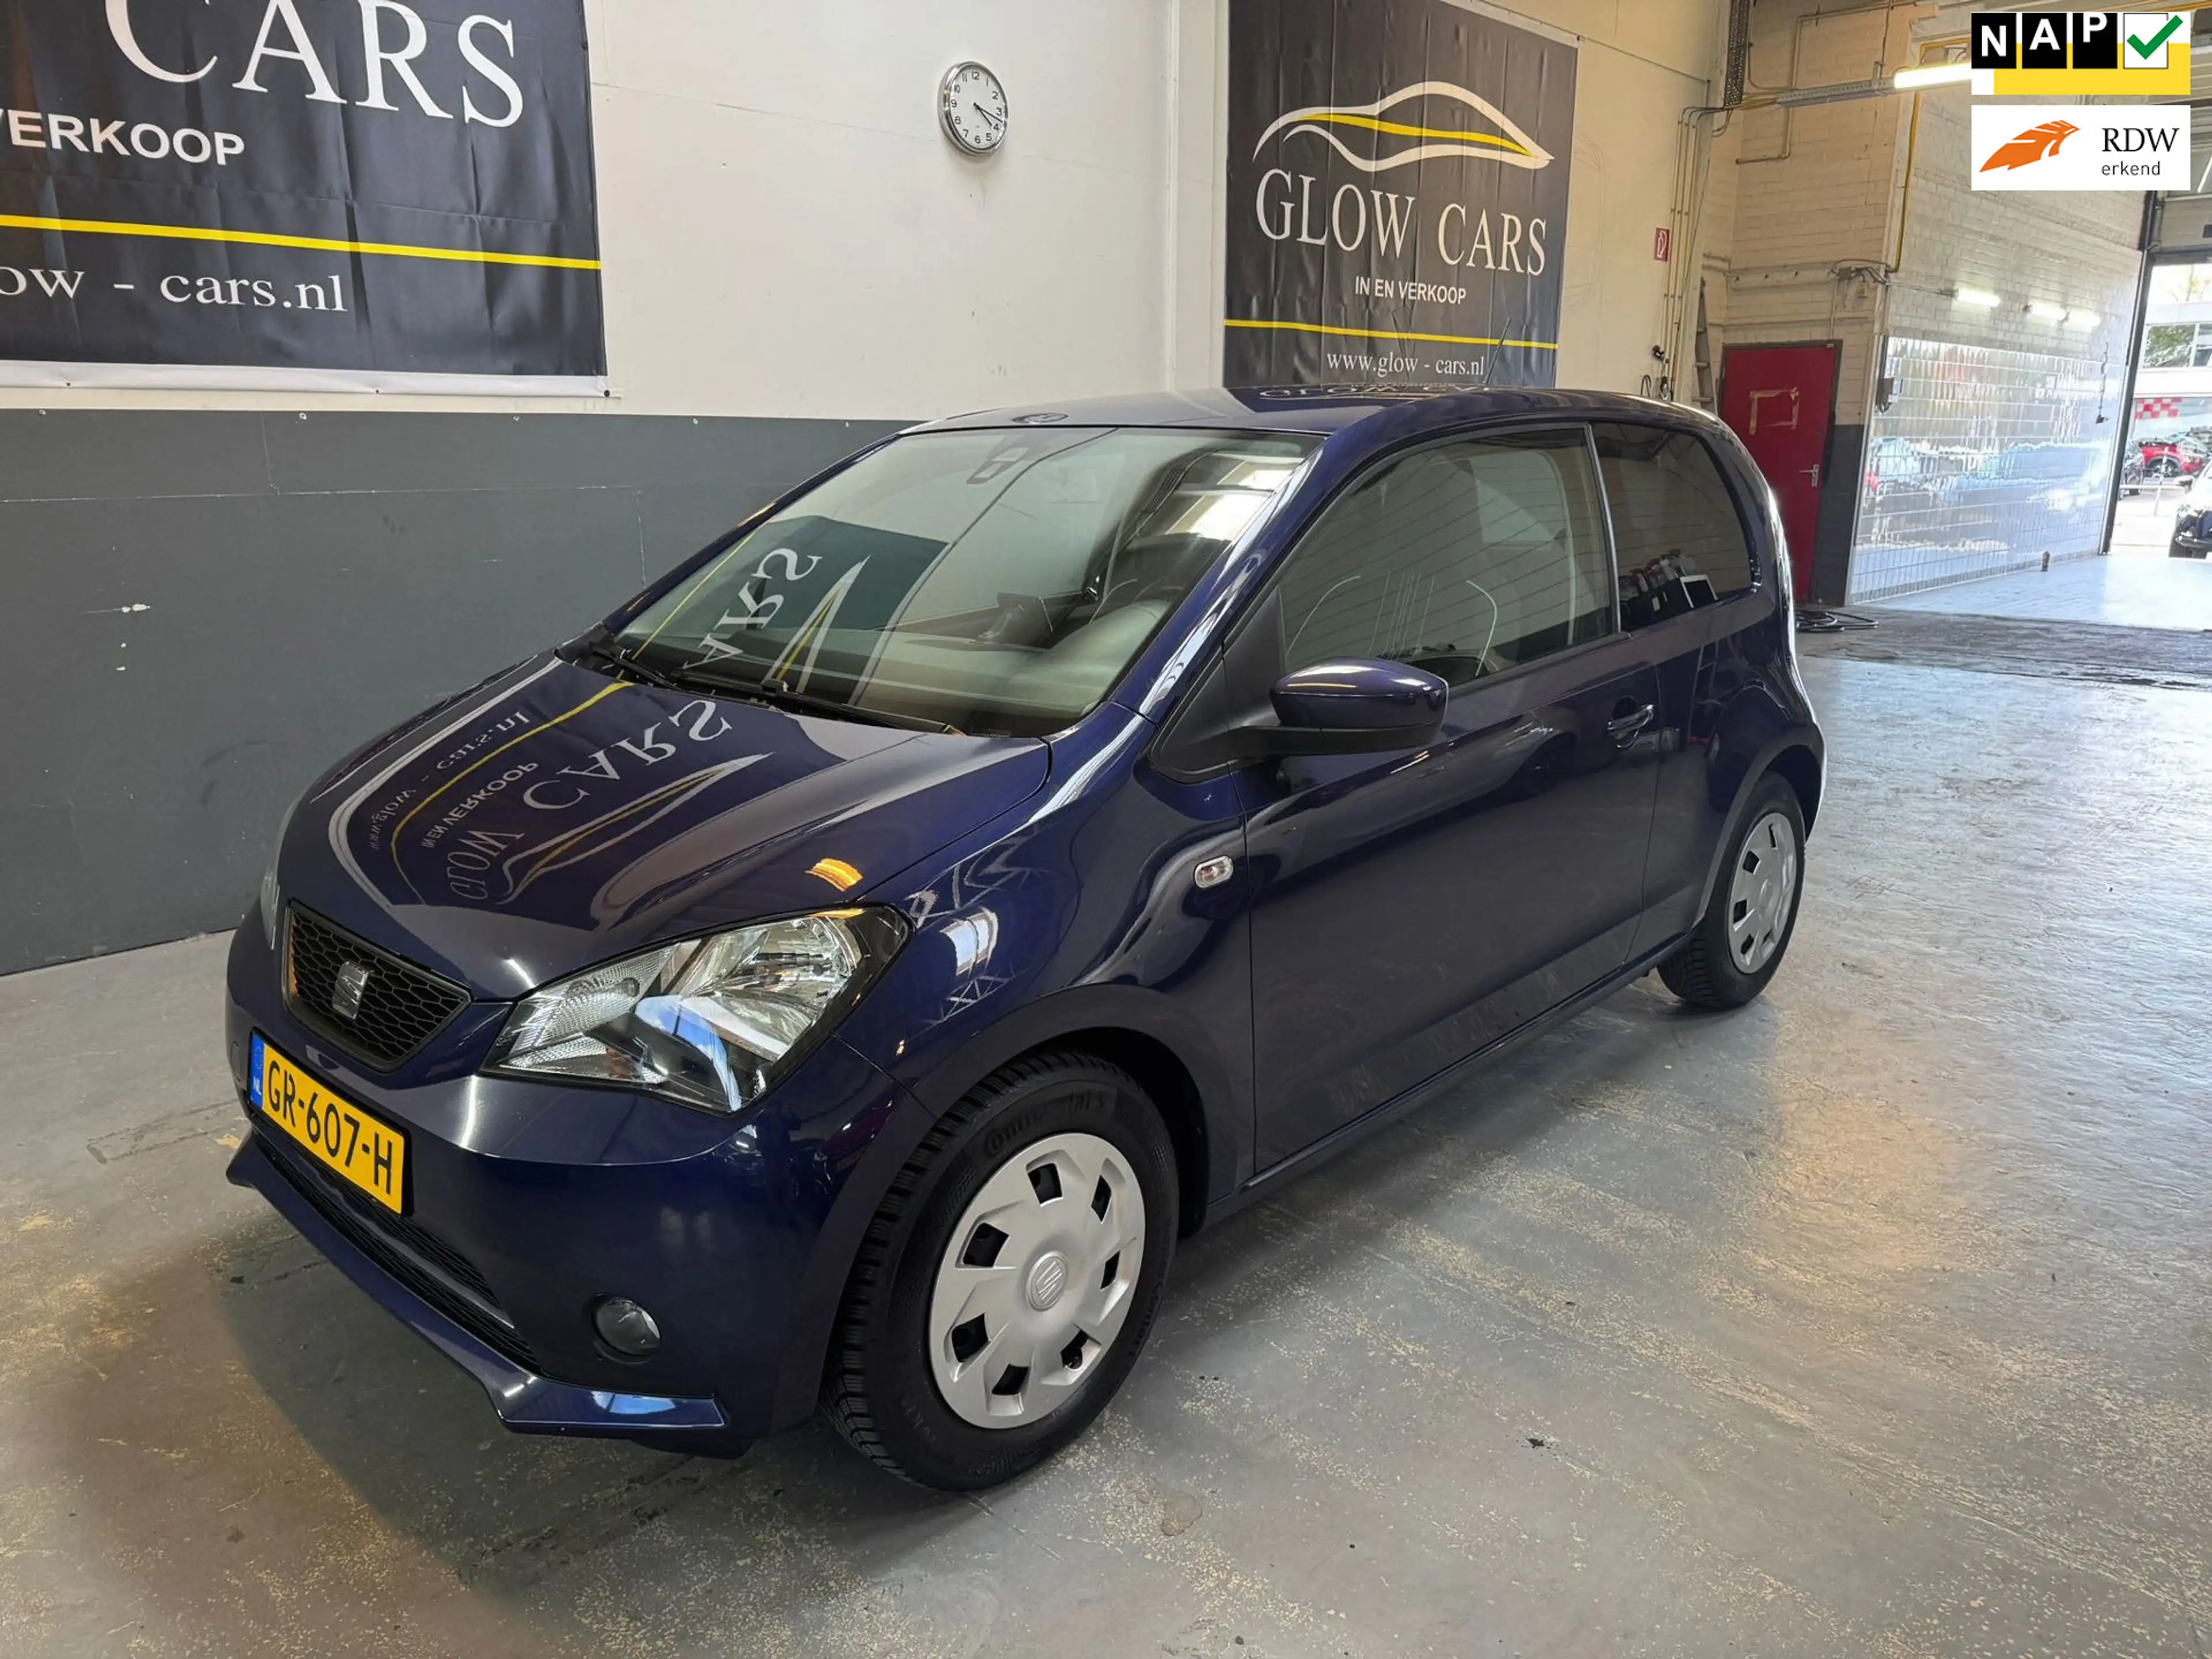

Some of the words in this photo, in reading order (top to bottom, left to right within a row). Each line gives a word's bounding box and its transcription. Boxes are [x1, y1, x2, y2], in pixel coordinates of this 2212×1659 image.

[105, 0, 523, 128] CARS
[972, 71, 979, 80] 12
[954, 85, 960, 93] 10
[992, 91, 998, 100] 2
[950, 100, 957, 108] 9
[996, 107, 1002, 116] 3
[955, 116, 961, 124] 8
[0, 109, 245, 165] ERKOOP
[963, 129, 969, 137] 7
[986, 132, 993, 141] 5
[1256, 168, 1415, 258] GLOW
[1438, 202, 1547, 276] CARS
[160, 275, 348, 312] cars.nl
[1355, 276, 1370, 295] IN
[1375, 279, 1394, 298] EN
[1398, 281, 1467, 305] VERKOOP
[1327, 351, 1418, 377] www.glow
[1435, 356, 1484, 375] cars.nl
[253, 1075, 262, 1096] NL
[267, 1060, 393, 1196] GR-607-H
